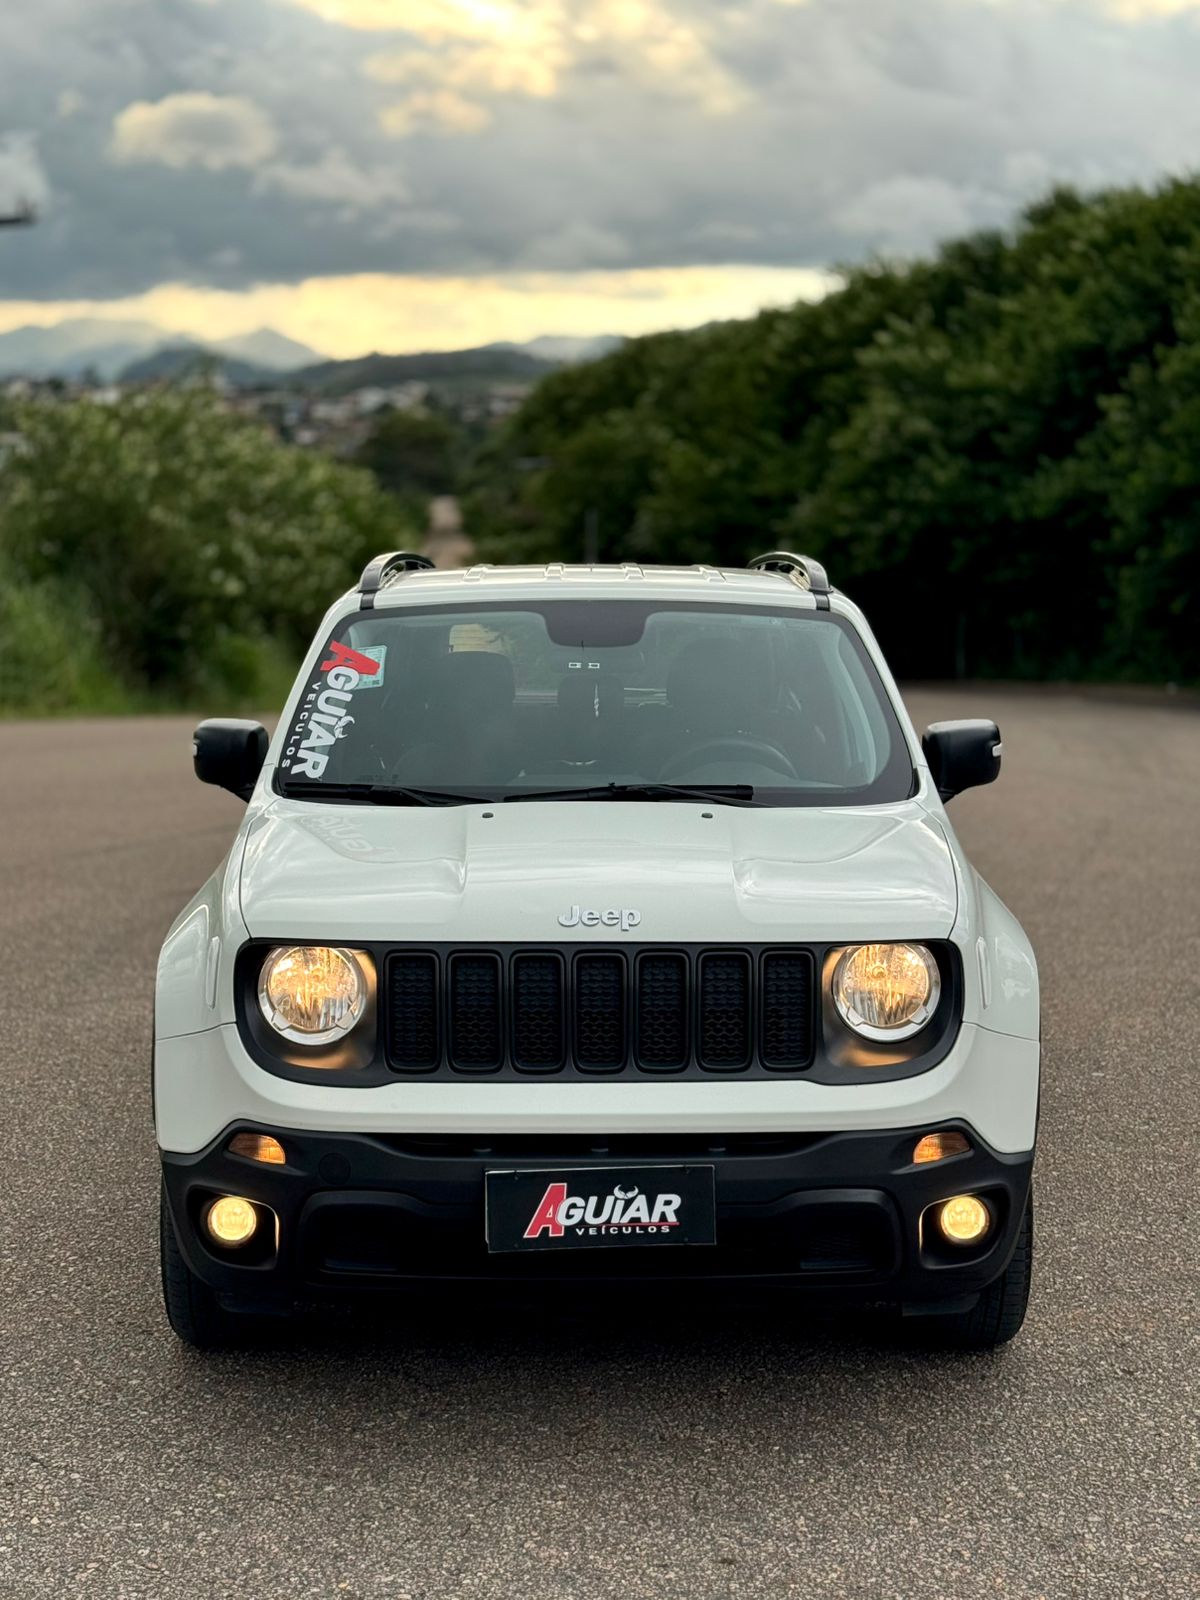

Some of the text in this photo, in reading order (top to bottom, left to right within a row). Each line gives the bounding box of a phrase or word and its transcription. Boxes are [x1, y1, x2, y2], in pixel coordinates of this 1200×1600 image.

[290, 640, 380, 779] AGUIAR
[557, 903, 641, 932] Jeep
[523, 1182, 682, 1239] AGUIAR
[575, 1224, 670, 1236] VEÍCULOS
